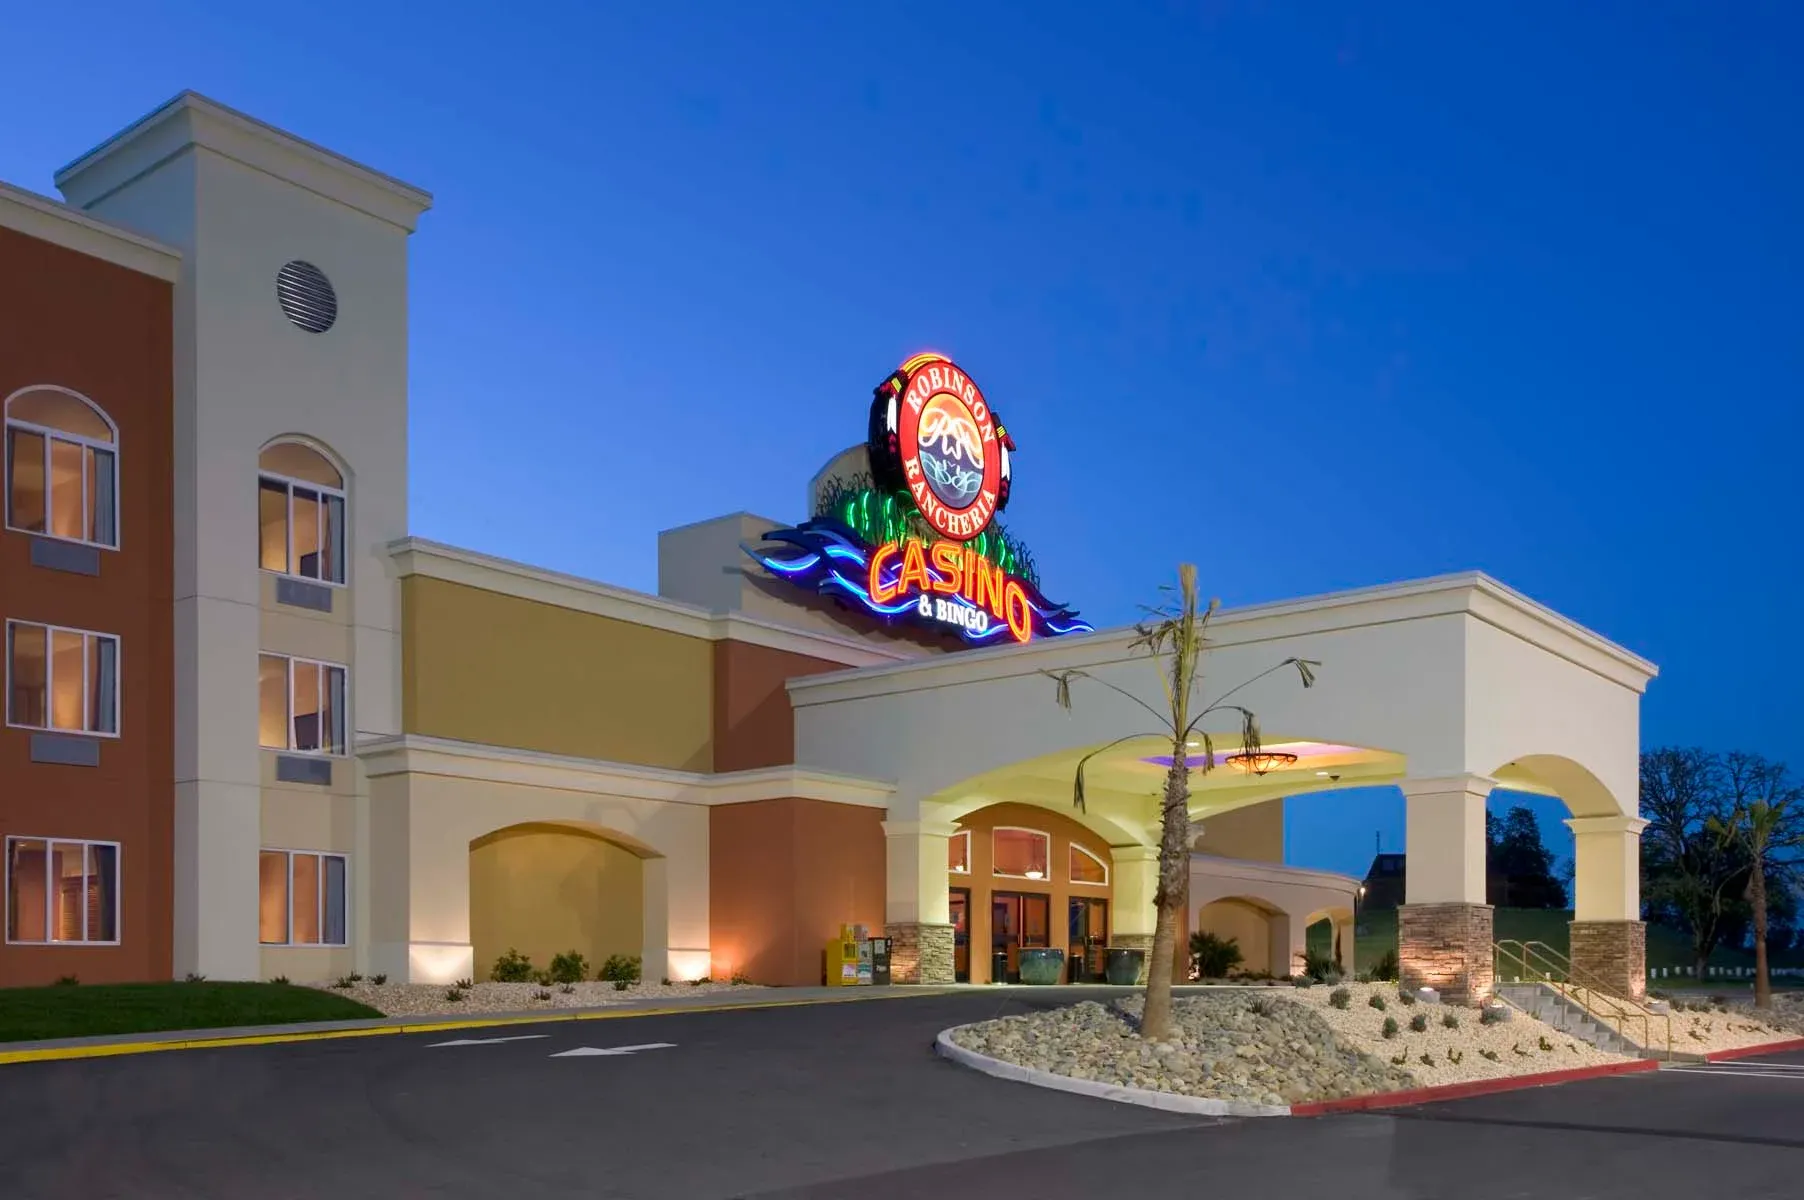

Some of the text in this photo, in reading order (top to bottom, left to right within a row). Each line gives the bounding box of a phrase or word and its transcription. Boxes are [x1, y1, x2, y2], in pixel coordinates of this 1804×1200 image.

[907, 366, 995, 443] ROBINSON
[904, 457, 996, 536] RANCHERIA
[869, 539, 1031, 642] CASINO
[919, 594, 988, 632] & BINGO
